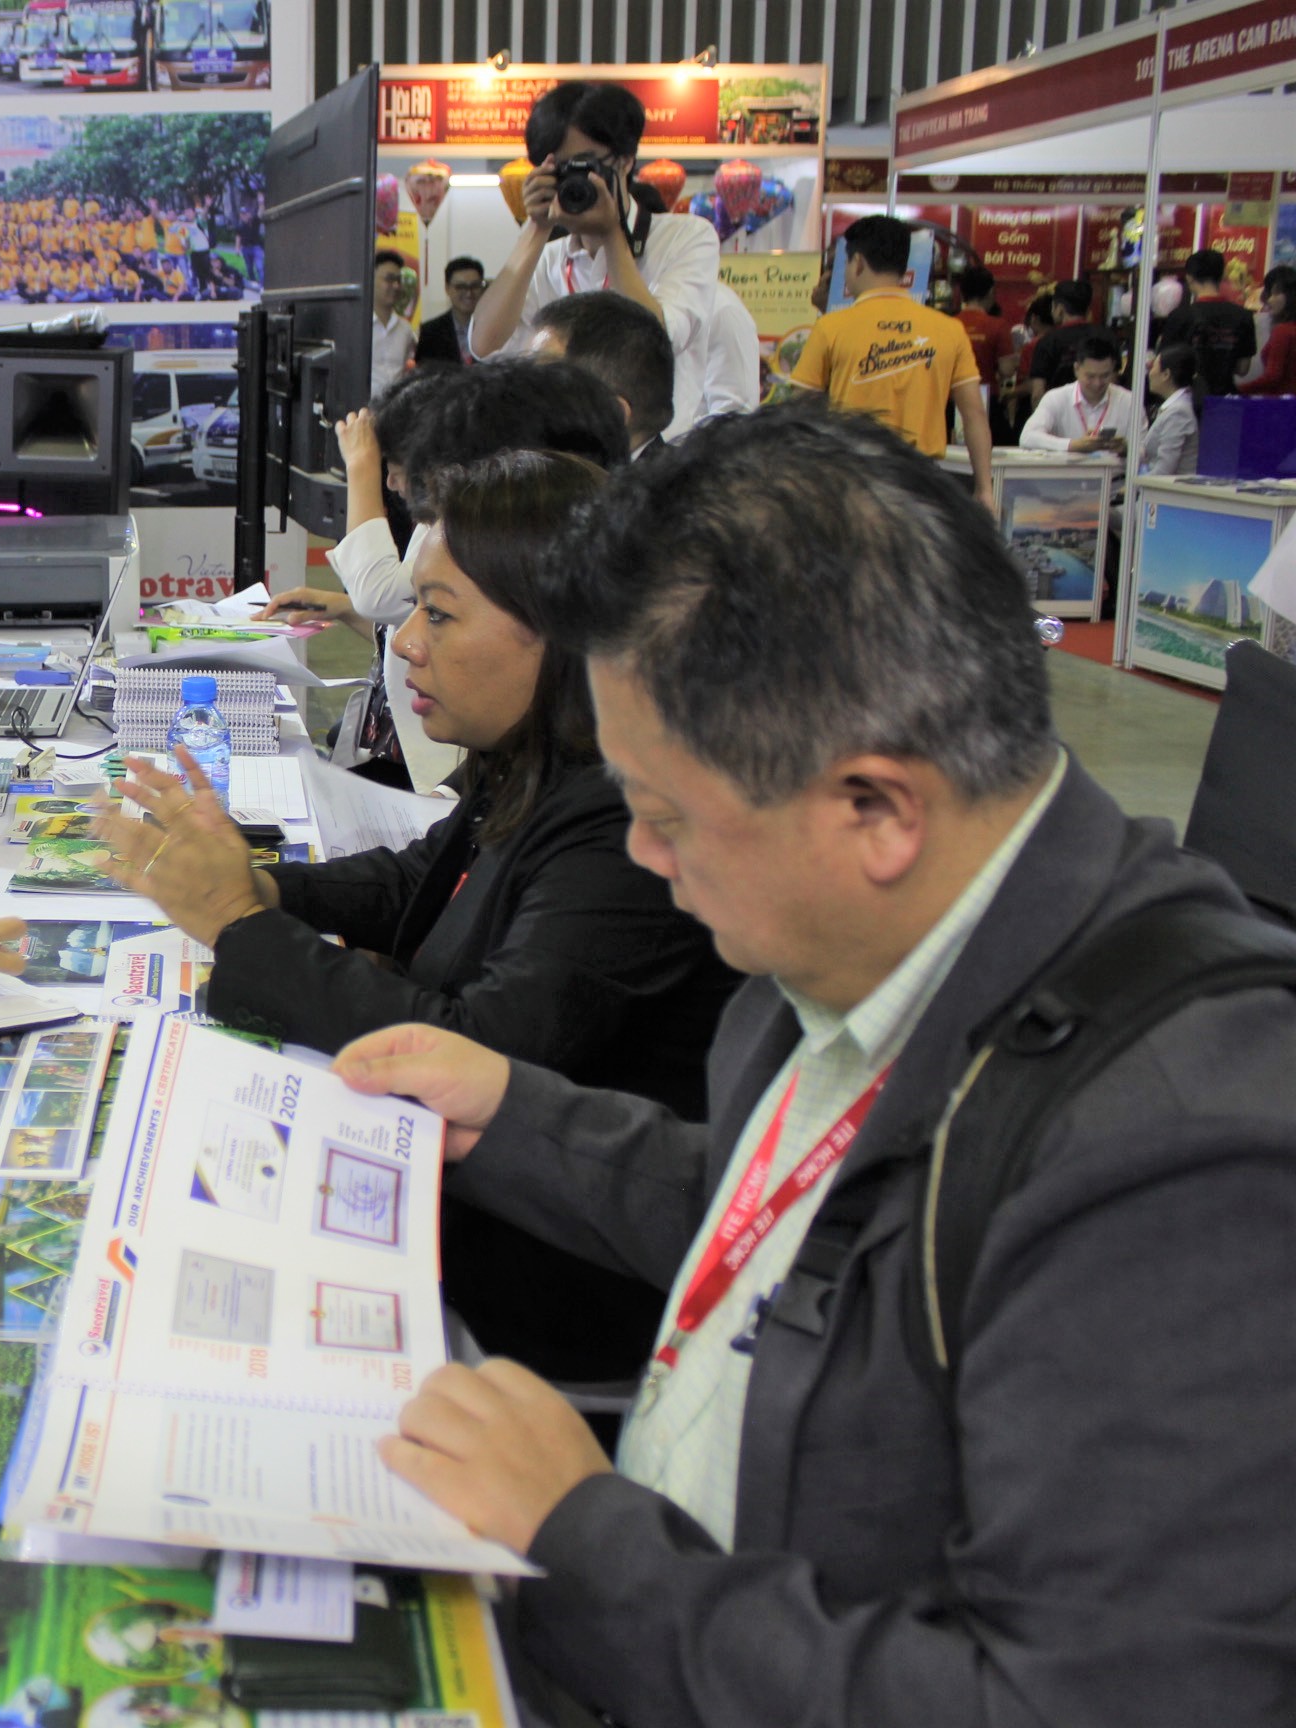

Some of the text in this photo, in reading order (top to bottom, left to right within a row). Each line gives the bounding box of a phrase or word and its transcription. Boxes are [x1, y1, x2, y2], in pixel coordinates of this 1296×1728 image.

[1135, 56, 1156, 82] 101
[1167, 47, 1190, 72] THE
[1192, 32, 1235, 65] ARENA
[1237, 22, 1268, 54] CAM
[859, 346, 937, 376] Discovery
[122, 953, 147, 995] Sacotravel
[280, 1073, 302, 1121] 2022
[128, 1022, 183, 1227] OUR ARCHIEVEMENTS & CERTIFICATES
[395, 1115, 415, 1160] 2022
[795, 1121, 857, 1188] ITE HCMC
[721, 1162, 770, 1240] ITE HCMC
[753, 1209, 776, 1237] ITE
[87, 1277, 112, 1339] Sacotravel
[248, 1348, 269, 1379] 2018
[392, 1362, 413, 1392] 2021
